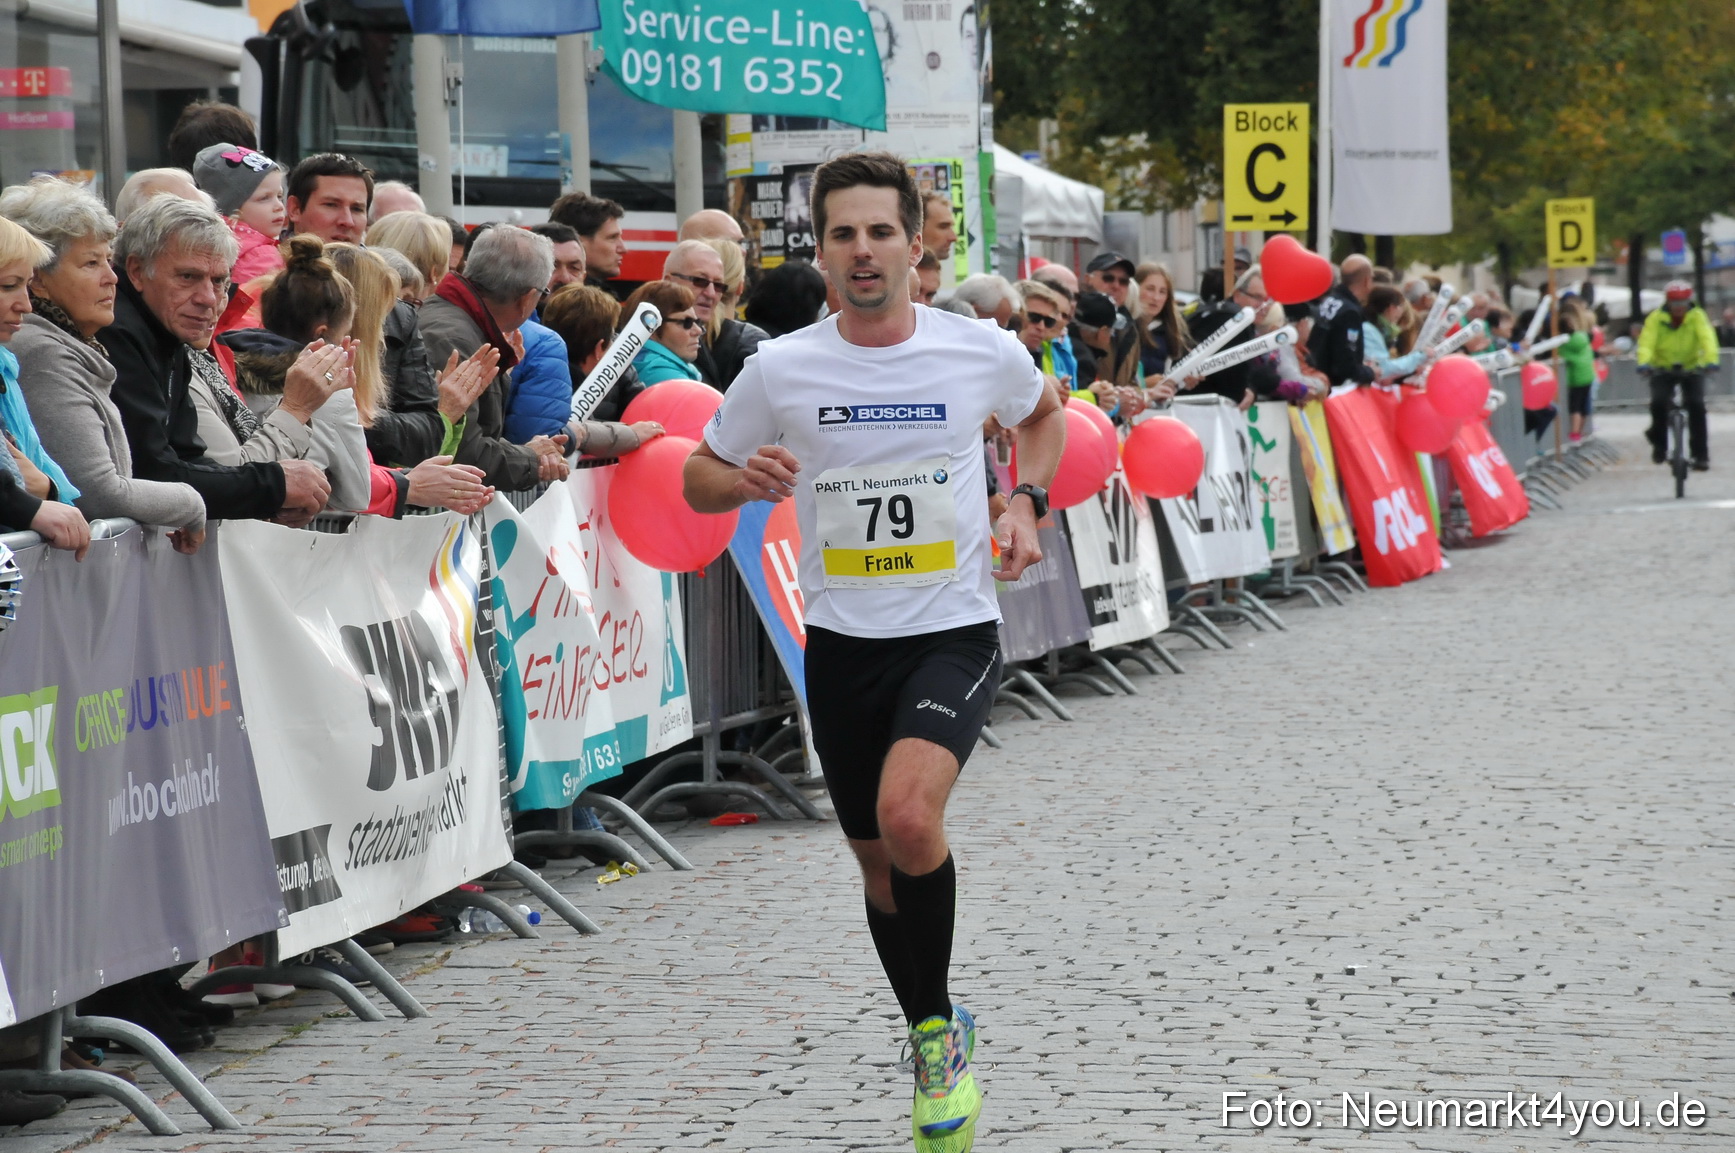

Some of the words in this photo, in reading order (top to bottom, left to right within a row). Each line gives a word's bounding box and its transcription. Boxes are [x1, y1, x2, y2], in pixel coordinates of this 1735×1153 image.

[623, 0, 865, 56] Service-Line:
[621, 48, 722, 92] 09181
[744, 56, 843, 101] 6352
[1235, 110, 1299, 132] Block
[1245, 142, 1287, 203] C
[1560, 220, 1582, 252] D
[818, 424, 892, 433] FEINSCHNEIDTECHNIK
[898, 423, 948, 431] WERKZEUGBAU
[857, 406, 942, 420] BÜSCHEL
[815, 481, 860, 494] PARTL
[863, 473, 929, 491] Neumarkt
[856, 493, 915, 542] 79
[864, 551, 915, 573] Frank
[75, 687, 127, 753] OFFICE
[929, 702, 958, 719] asics
[0, 702, 57, 803] CK
